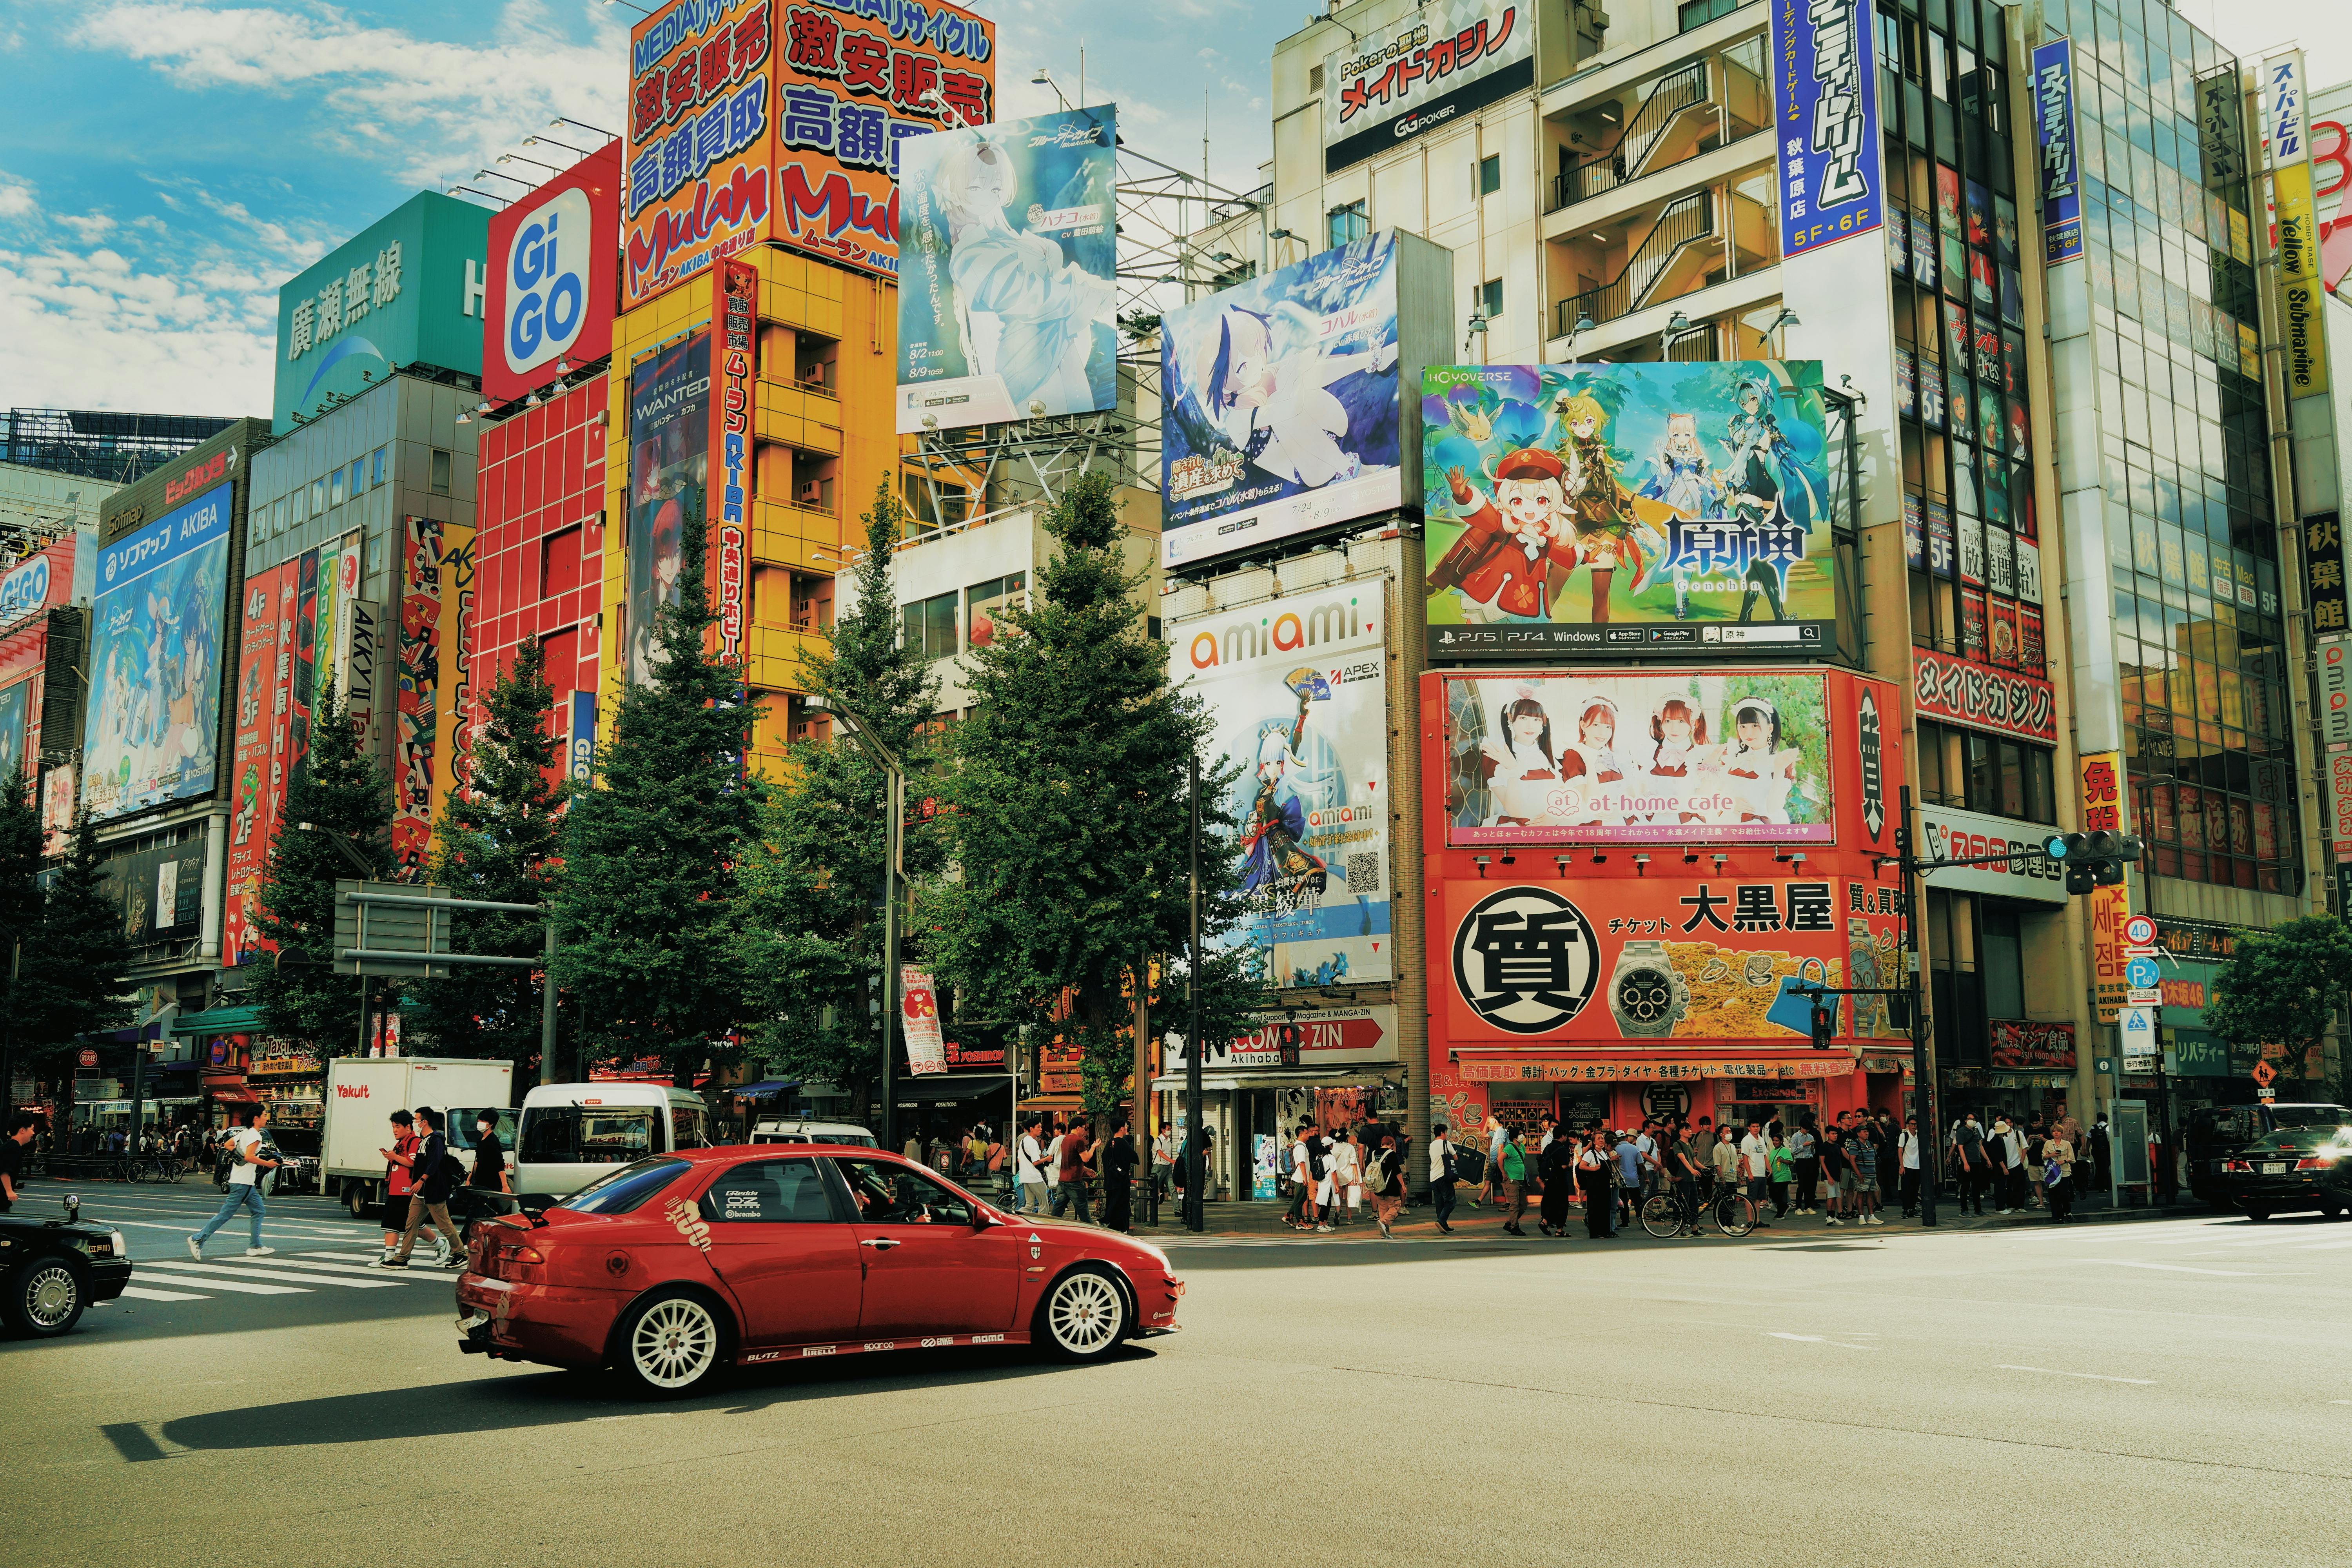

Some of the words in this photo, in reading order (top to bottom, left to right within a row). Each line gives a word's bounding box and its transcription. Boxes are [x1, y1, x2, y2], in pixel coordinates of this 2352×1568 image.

[633, 2, 767, 141] 激安販売
[786, 8, 986, 128] 激安販売
[1340, 6, 1515, 123] メイドカジノ
[2272, 62, 2299, 159] スーパービル
[630, 76, 764, 216] 高額買取
[1028, 125, 1104, 148] ブルーアーカイブ
[1787, 139, 1806, 221] 秋葉原店
[627, 162, 769, 299] Mulan
[1073, 225, 1104, 237] 豊田萌絵
[2048, 229, 2079, 243] 秋葉原店
[2304, 213, 2312, 245] HOBBY
[514, 212, 558, 291] Gi
[2278, 214, 2305, 276] Yellow
[1313, 253, 1387, 292] ブルーアーカイブ
[1915, 252, 1936, 285] 7F
[511, 272, 581, 360] GO
[728, 297, 749, 314] 買取
[727, 314, 749, 332] 販売
[728, 333, 749, 350] 市場
[1333, 340, 1343, 348] CV
[1345, 325, 1382, 345] 赤尾ひかる
[2239, 335, 2258, 354] GAME
[2287, 287, 2315, 388] Submarine
[909, 348, 926, 359] 8/2
[909, 367, 926, 378] 8/9
[637, 376, 710, 420] WANTED
[1922, 390, 1944, 424] 6F
[165, 451, 225, 505] ビックカメラ
[1360, 483, 1391, 497] YOSTAR
[1292, 502, 1312, 515] 7/24
[1314, 508, 1329, 520] 8/9
[108, 505, 142, 535] Sofmap
[120, 525, 171, 570] ソフマップ
[180, 503, 218, 541] AKIBA
[1662, 492, 1805, 602] 原神
[1930, 536, 1953, 570] 5F
[2136, 530, 2207, 590] 秋葉館
[2214, 557, 2231, 579] 中古
[2236, 564, 2254, 586] Mac
[2307, 521, 2345, 630] 秋葉館
[1677, 580, 1761, 590] Genshin
[2216, 579, 2230, 596] 販売
[2240, 587, 2254, 604] 買取
[247, 588, 266, 620] 4F
[245, 620, 274, 641] カードゲーム
[1191, 598, 1357, 669] amiami
[1554, 632, 1600, 642] Windows
[1726, 630, 1745, 639] 原神
[244, 636, 274, 655] オンラインゲーム
[1343, 662, 1379, 677] APEX
[1345, 673, 1377, 682] TOYS
[1918, 659, 2049, 731] メイドカジノ
[2325, 646, 2350, 739] amiami
[241, 695, 259, 728] 3F
[238, 744, 267, 762] 麻雀・パズル
[191, 765, 209, 779] YOSTAR
[1555, 795, 1570, 806] at
[1589, 795, 1679, 811] at-home
[1688, 793, 1733, 811] cafe
[1309, 804, 1372, 826] amiami
[234, 813, 252, 846] 2F
[232, 849, 251, 865] プライズ
[230, 863, 260, 881] レトロゲーム
[229, 880, 255, 898] 音楽ゲーム
[177, 911, 195, 921] RELEASE
[1608, 917, 1672, 935] チケット
[1679, 882, 1835, 934] 大黒屋
[2131, 924, 2149, 938] 40
[1469, 907, 1586, 1015] 質
[2133, 965, 2146, 982] P
[2143, 976, 2152, 985] 60
[1297, 1011, 1326, 1020] Magazine
[1333, 1008, 1370, 1016] MANGA-ZIN
[1311, 1024, 1343, 1047] ZIN
[961, 1050, 1004, 1062] YOSHINOY
[2178, 1042, 2225, 1062] リバティー
[262, 1061, 293, 1071] 海外向け電気製品
[1462, 1065, 1517, 1079] 高価買取
[1799, 1062, 1855, 1076] 無料査定
[2126, 1060, 2151, 1068] 歩行者優先
[337, 1085, 370, 1098] Yakult
[1569, 1109, 1600, 1119] 大黒屋
[747, 1352, 779, 1361] BLITZ
[803, 1345, 836, 1356] PIRELLI
[864, 1341, 894, 1351] sparco
[936, 1337, 953, 1346] ENKEI
